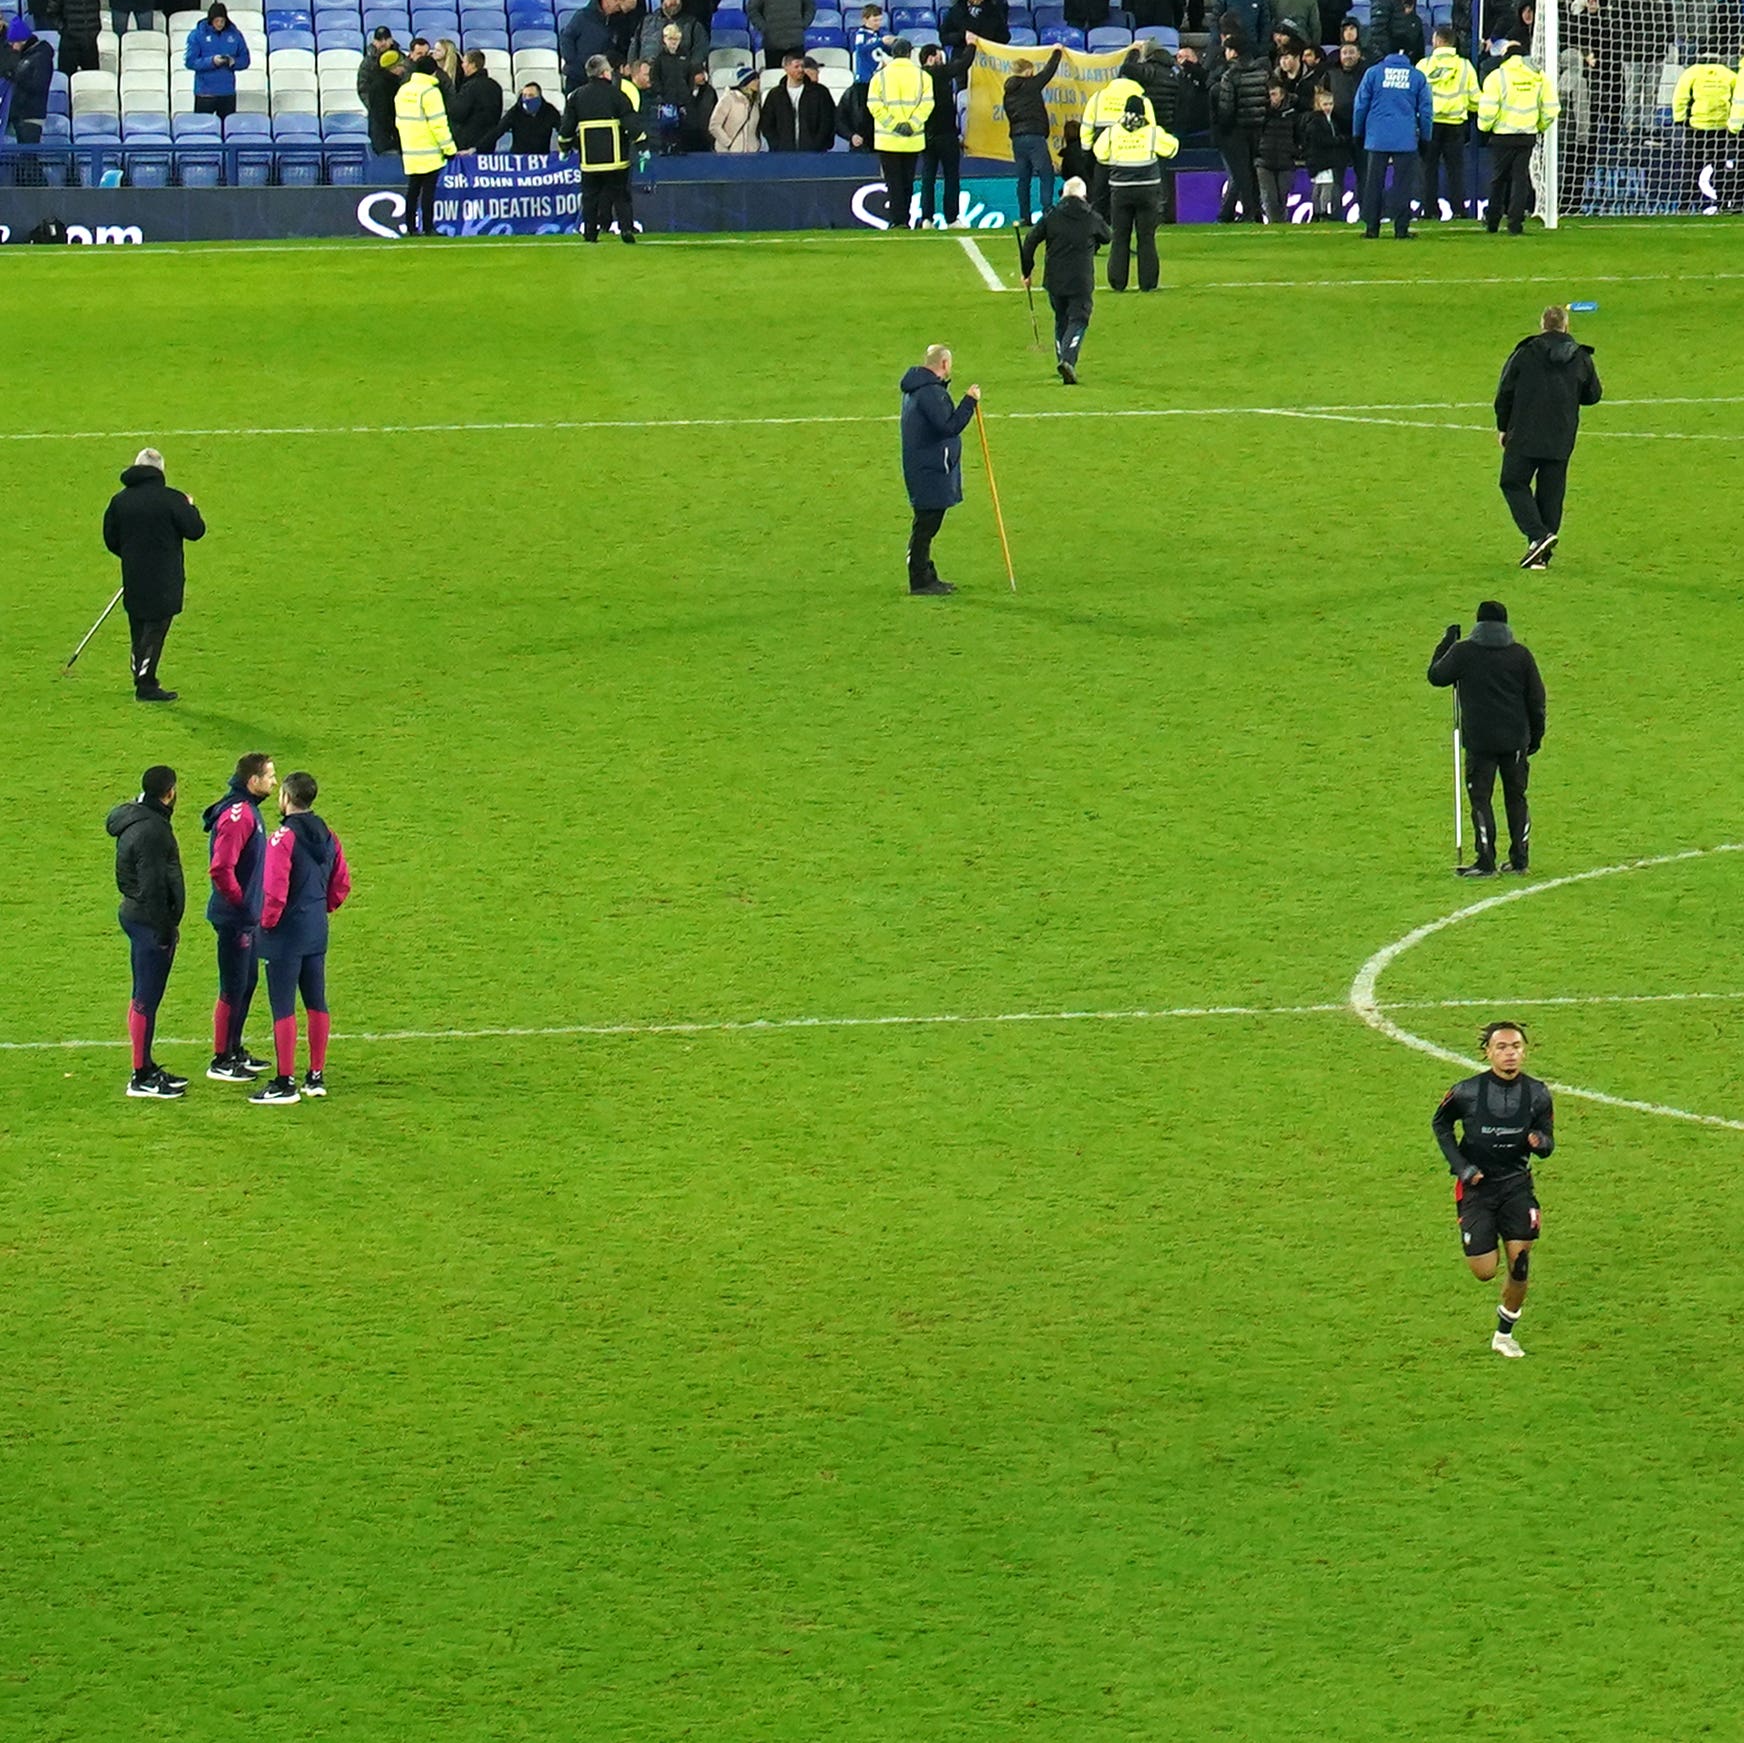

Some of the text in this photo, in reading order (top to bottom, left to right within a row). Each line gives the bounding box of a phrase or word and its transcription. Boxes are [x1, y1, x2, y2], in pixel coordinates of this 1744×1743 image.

[477, 154, 549, 172] BUILT BY
[443, 170, 582, 190] SIR JOHN MOORES
[433, 199, 459, 222] OW
[462, 198, 485, 221] ON
[489, 196, 551, 220] DEATHS
